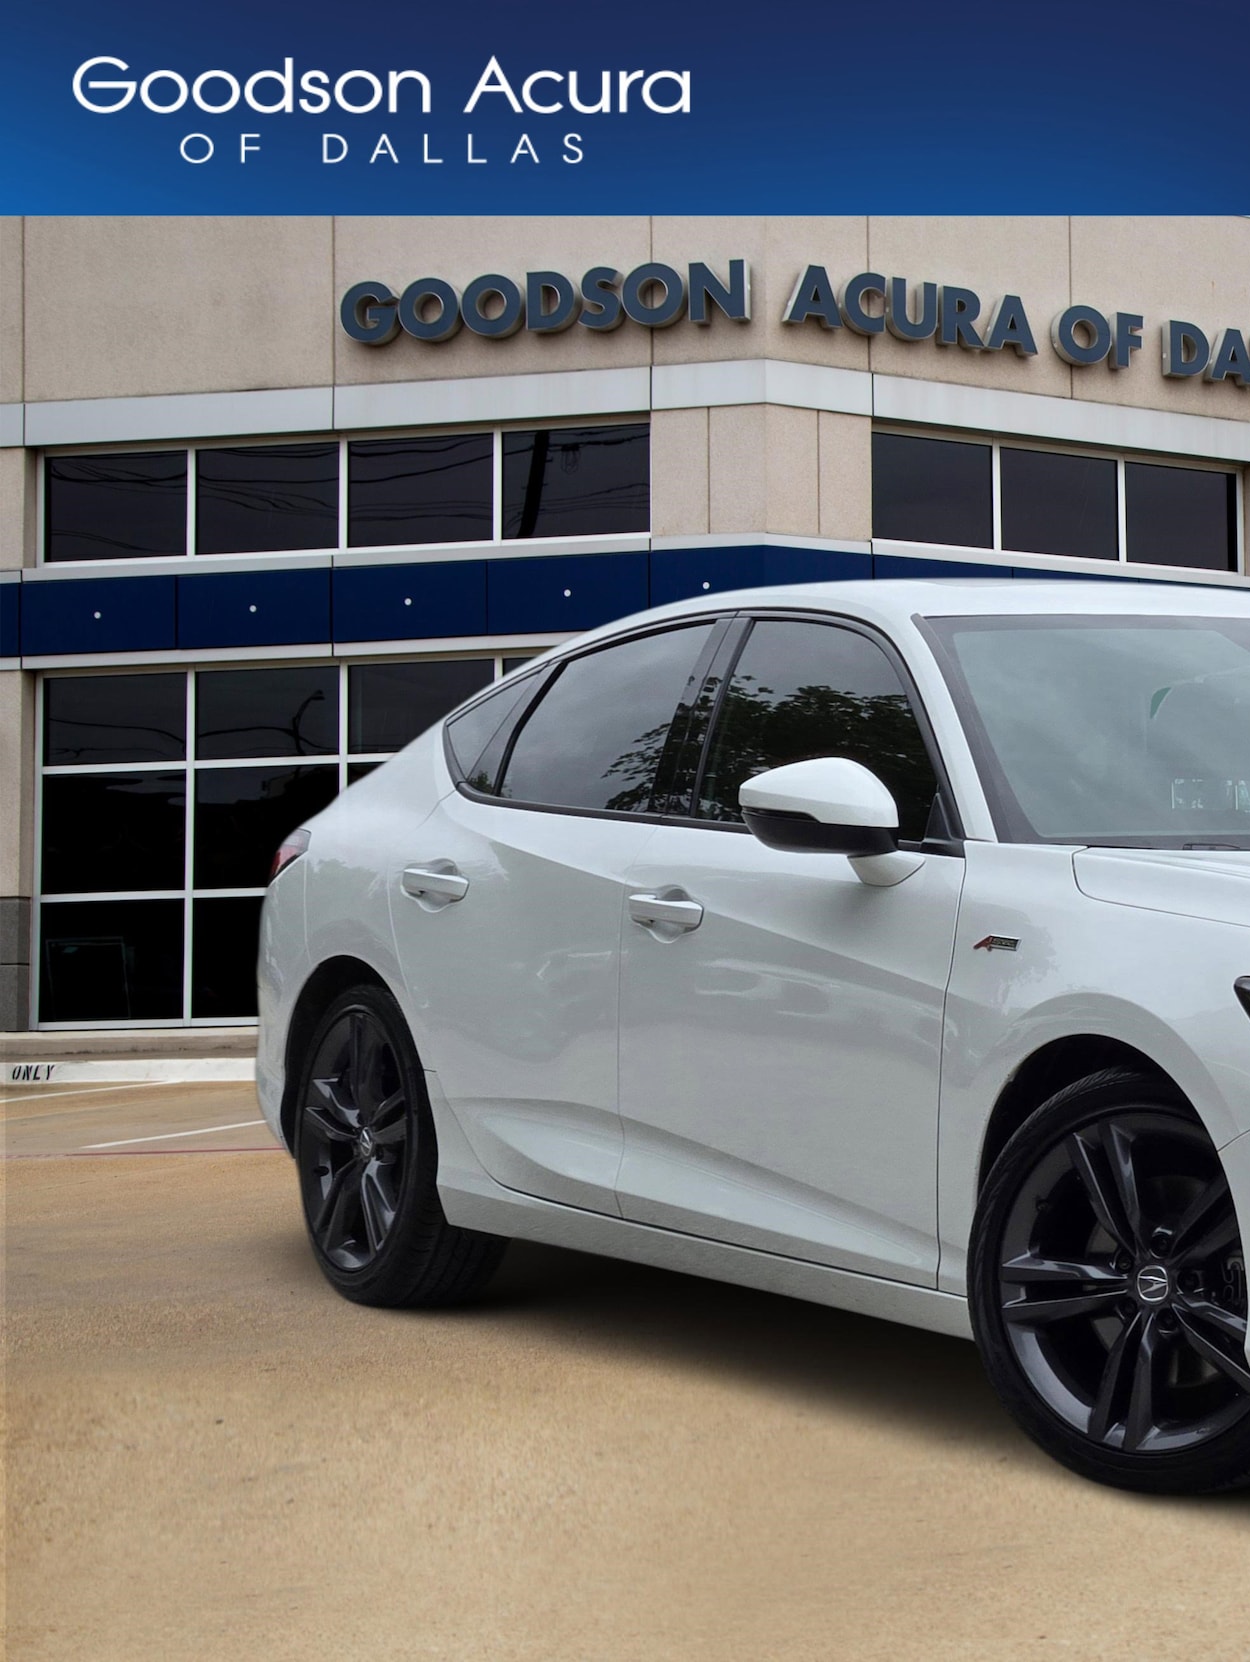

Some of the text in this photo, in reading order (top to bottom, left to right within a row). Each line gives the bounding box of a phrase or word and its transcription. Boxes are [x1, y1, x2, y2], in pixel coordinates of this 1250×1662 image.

[340, 258, 751, 345] GOODSON
[783, 264, 1038, 357] ACURA
[1054, 304, 1144, 369] OF
[12, 1064, 55, 1081] ONLY
